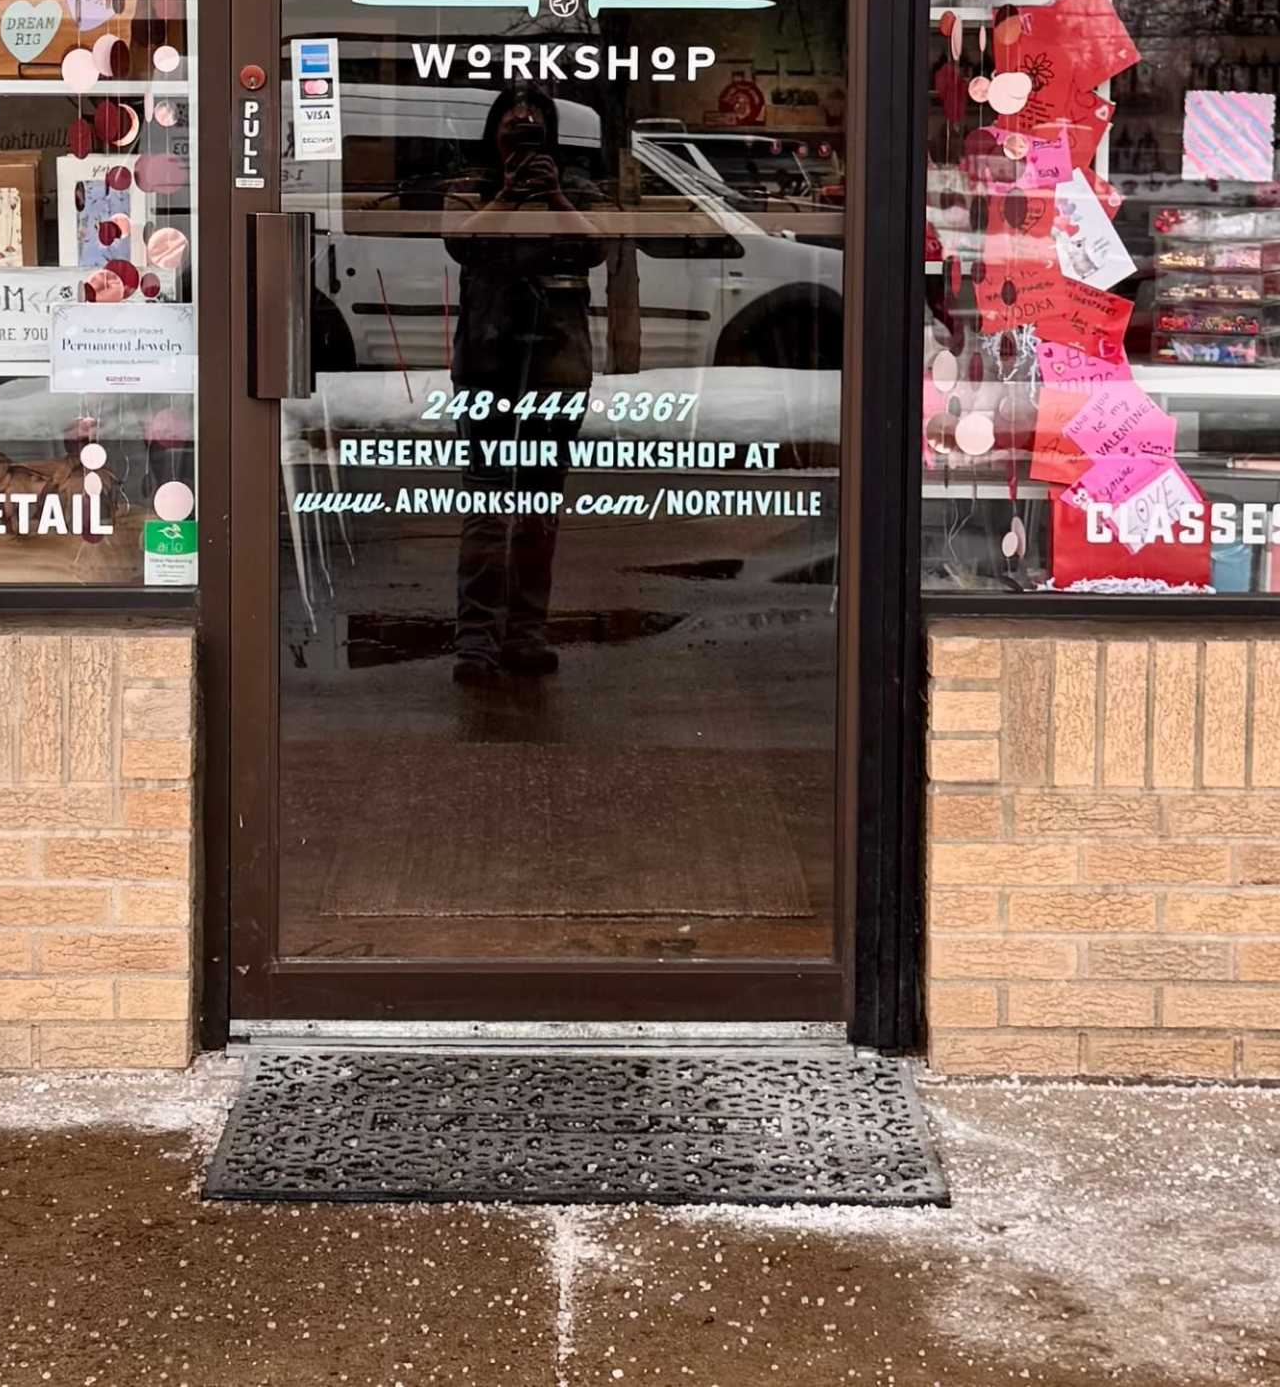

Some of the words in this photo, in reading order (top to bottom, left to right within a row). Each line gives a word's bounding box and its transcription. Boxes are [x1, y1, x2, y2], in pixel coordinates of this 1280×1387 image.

[6, 16, 56, 30] DREAM
[411, 42, 717, 82] WORKSHOP
[305, 110, 332, 121] VISA
[243, 101, 260, 175] PULL
[23, 327, 50, 342] YOU
[62, 337, 131, 352] Permanent
[134, 337, 183, 356] Jewelry
[339, 439, 471, 467] RESERVE
[479, 439, 558, 467] YOUR
[569, 440, 736, 469] WORKSHOP
[744, 442, 780, 469] AT
